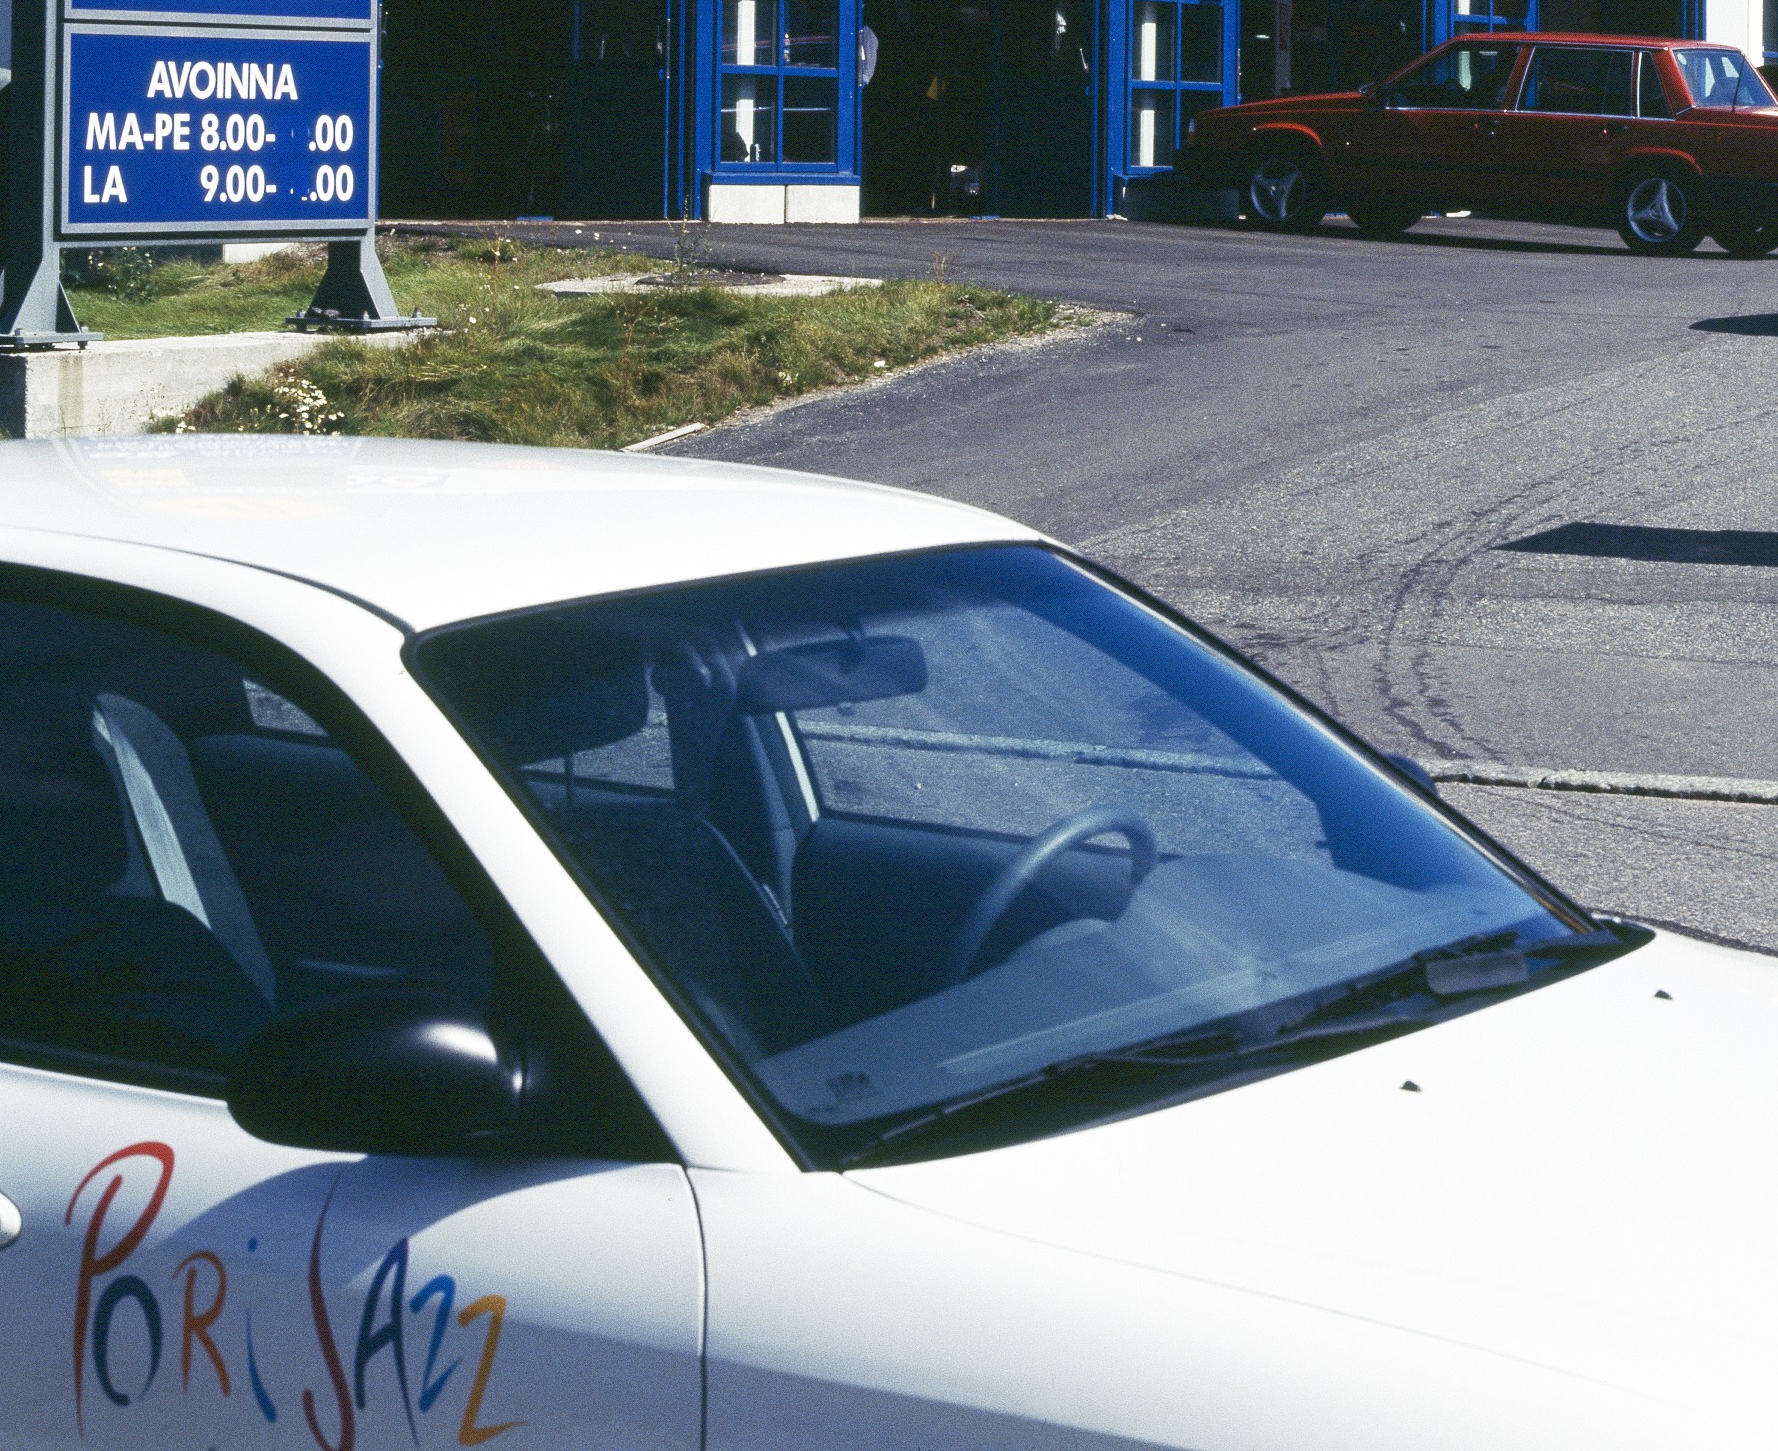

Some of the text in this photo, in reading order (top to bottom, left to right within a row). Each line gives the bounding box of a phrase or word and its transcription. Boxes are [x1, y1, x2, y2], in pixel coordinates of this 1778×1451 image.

[146, 60, 299, 101] AVOINNA
[85, 112, 190, 151] MA-PE
[200, 113, 276, 151] 8.00-
[83, 164, 127, 203] LA
[200, 164, 276, 202] 9.00-
